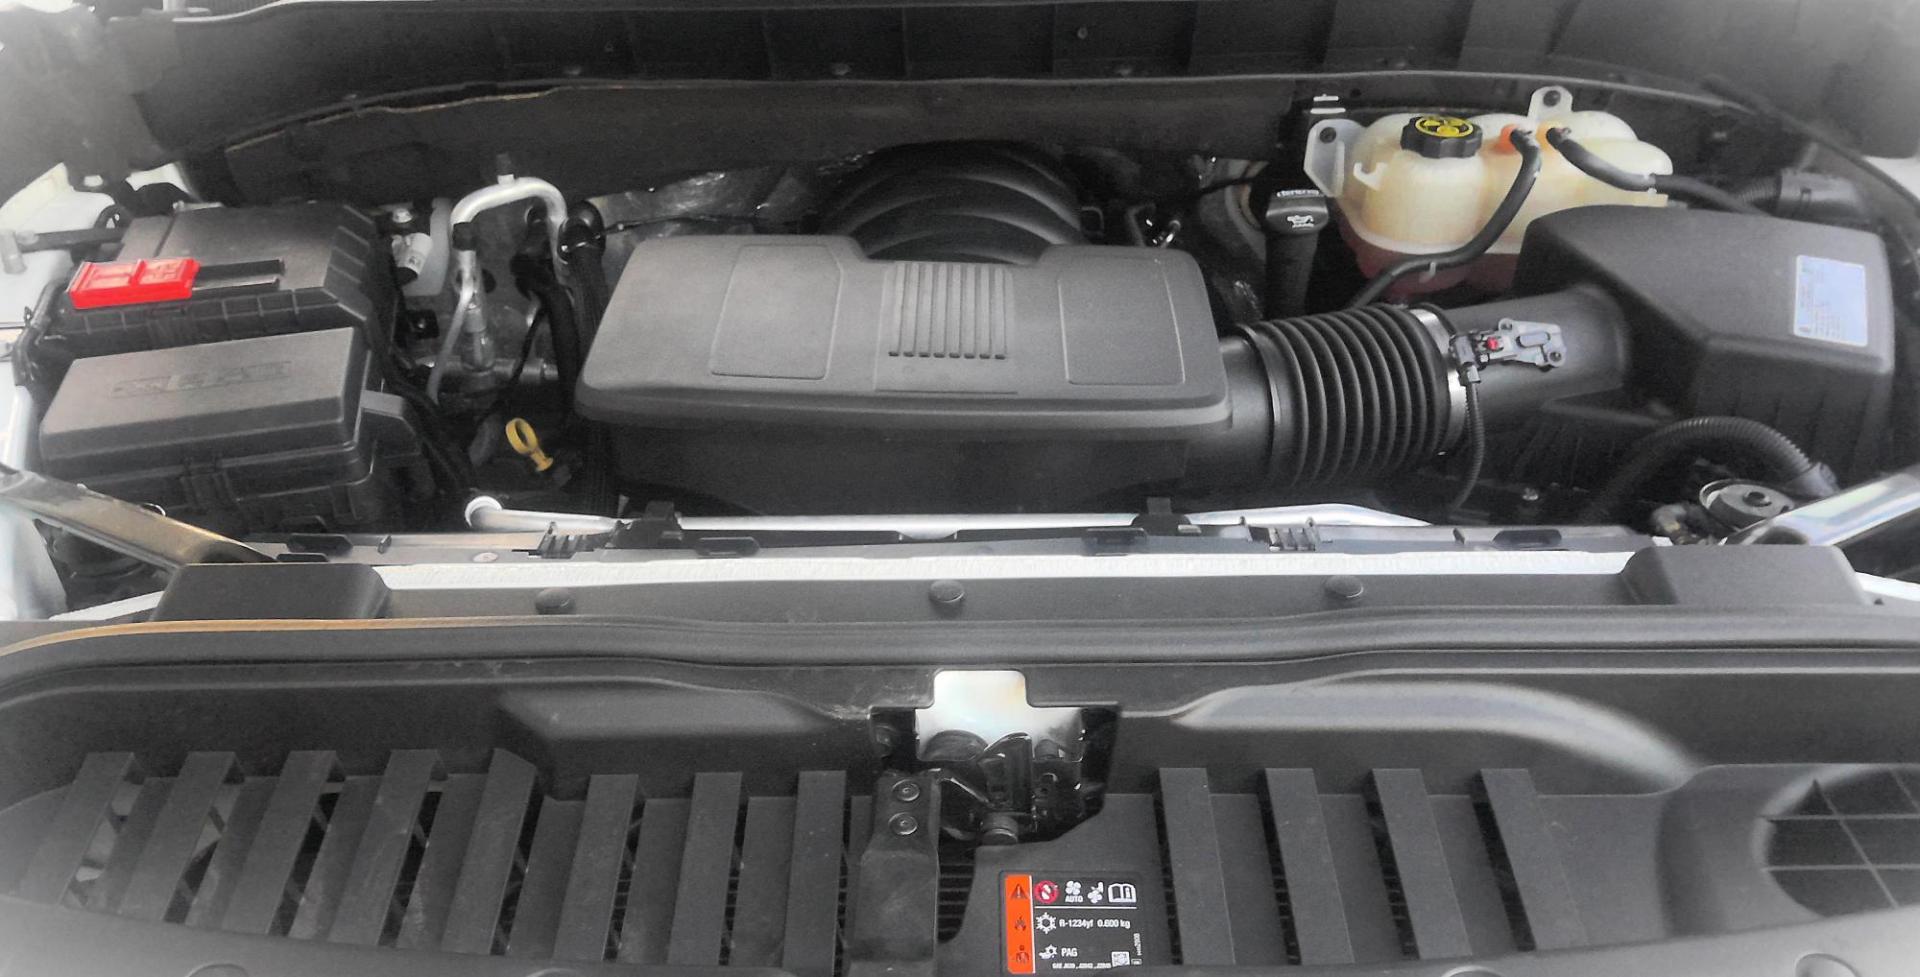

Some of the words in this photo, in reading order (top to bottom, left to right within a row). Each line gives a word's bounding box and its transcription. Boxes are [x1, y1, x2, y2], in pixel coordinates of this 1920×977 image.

[1065, 895, 1084, 903] AUTO
[1059, 919, 1094, 929] R-1234yf
[1120, 919, 1131, 929] kg
[1061, 948, 1078, 957] PAG
